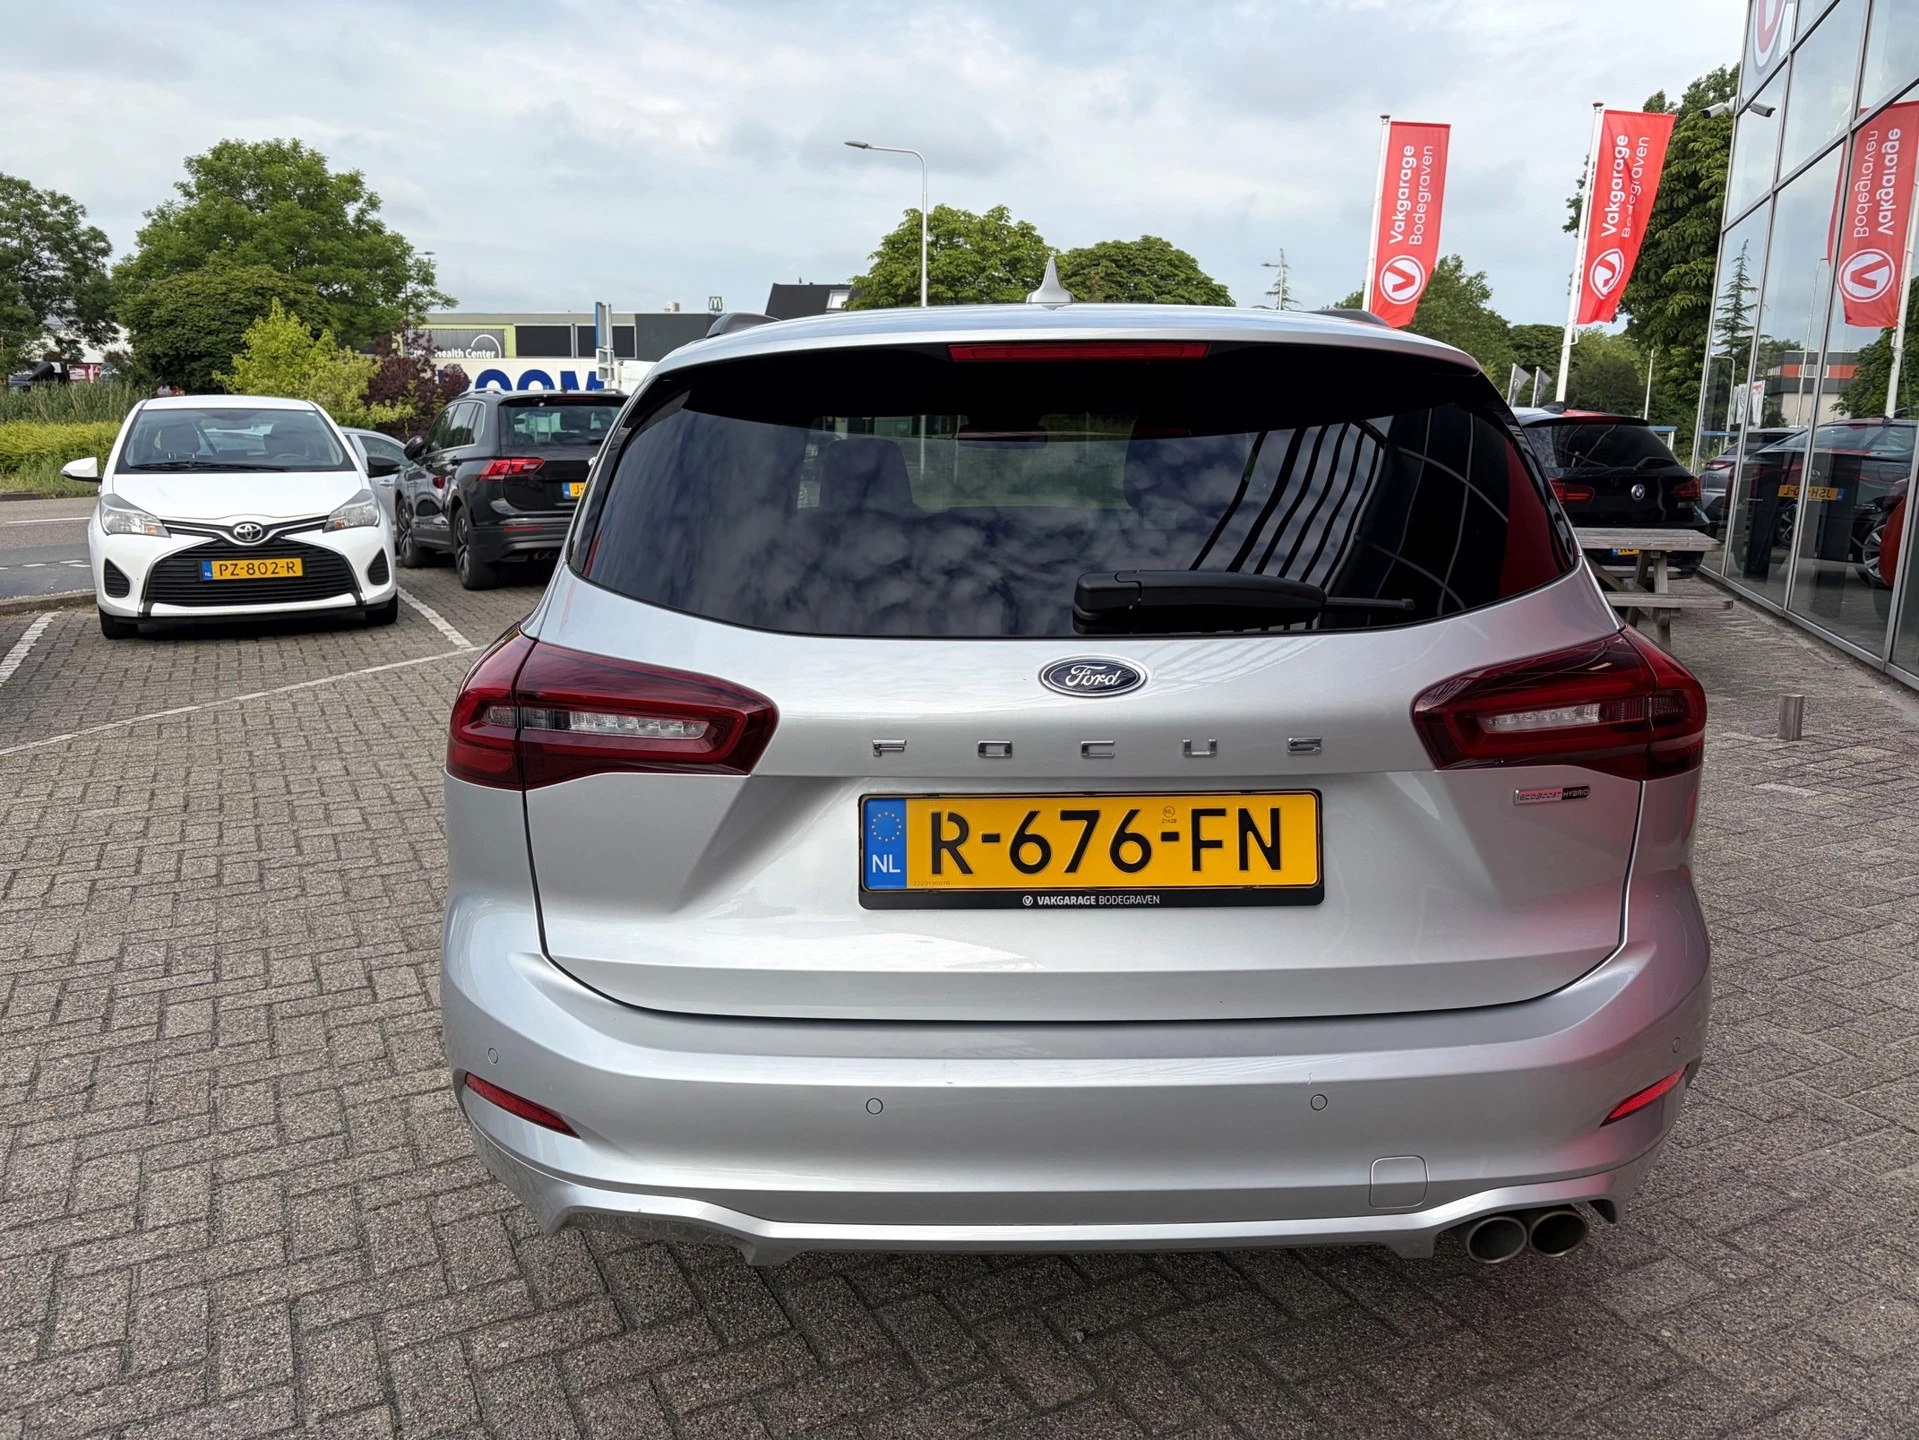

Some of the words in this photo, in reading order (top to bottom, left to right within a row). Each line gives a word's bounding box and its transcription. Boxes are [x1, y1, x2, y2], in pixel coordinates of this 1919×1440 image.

[1389, 145, 1417, 245] Vakgarage
[1409, 145, 1433, 245] Bodegraven
[1601, 135, 1629, 237] Vakgarage
[1622, 136, 1650, 238] Bodegraven
[465, 349, 496, 359] Center
[219, 561, 297, 577] PZ-802-R
[1065, 665, 1121, 686] Ford
[873, 737, 1322, 758] FOCUS
[930, 807, 1282, 875] R-676-FN
[872, 853, 901, 873] NL
[1037, 895, 1097, 905] VAKGARAGE
[1098, 895, 1160, 905] BODEGRAVEN
